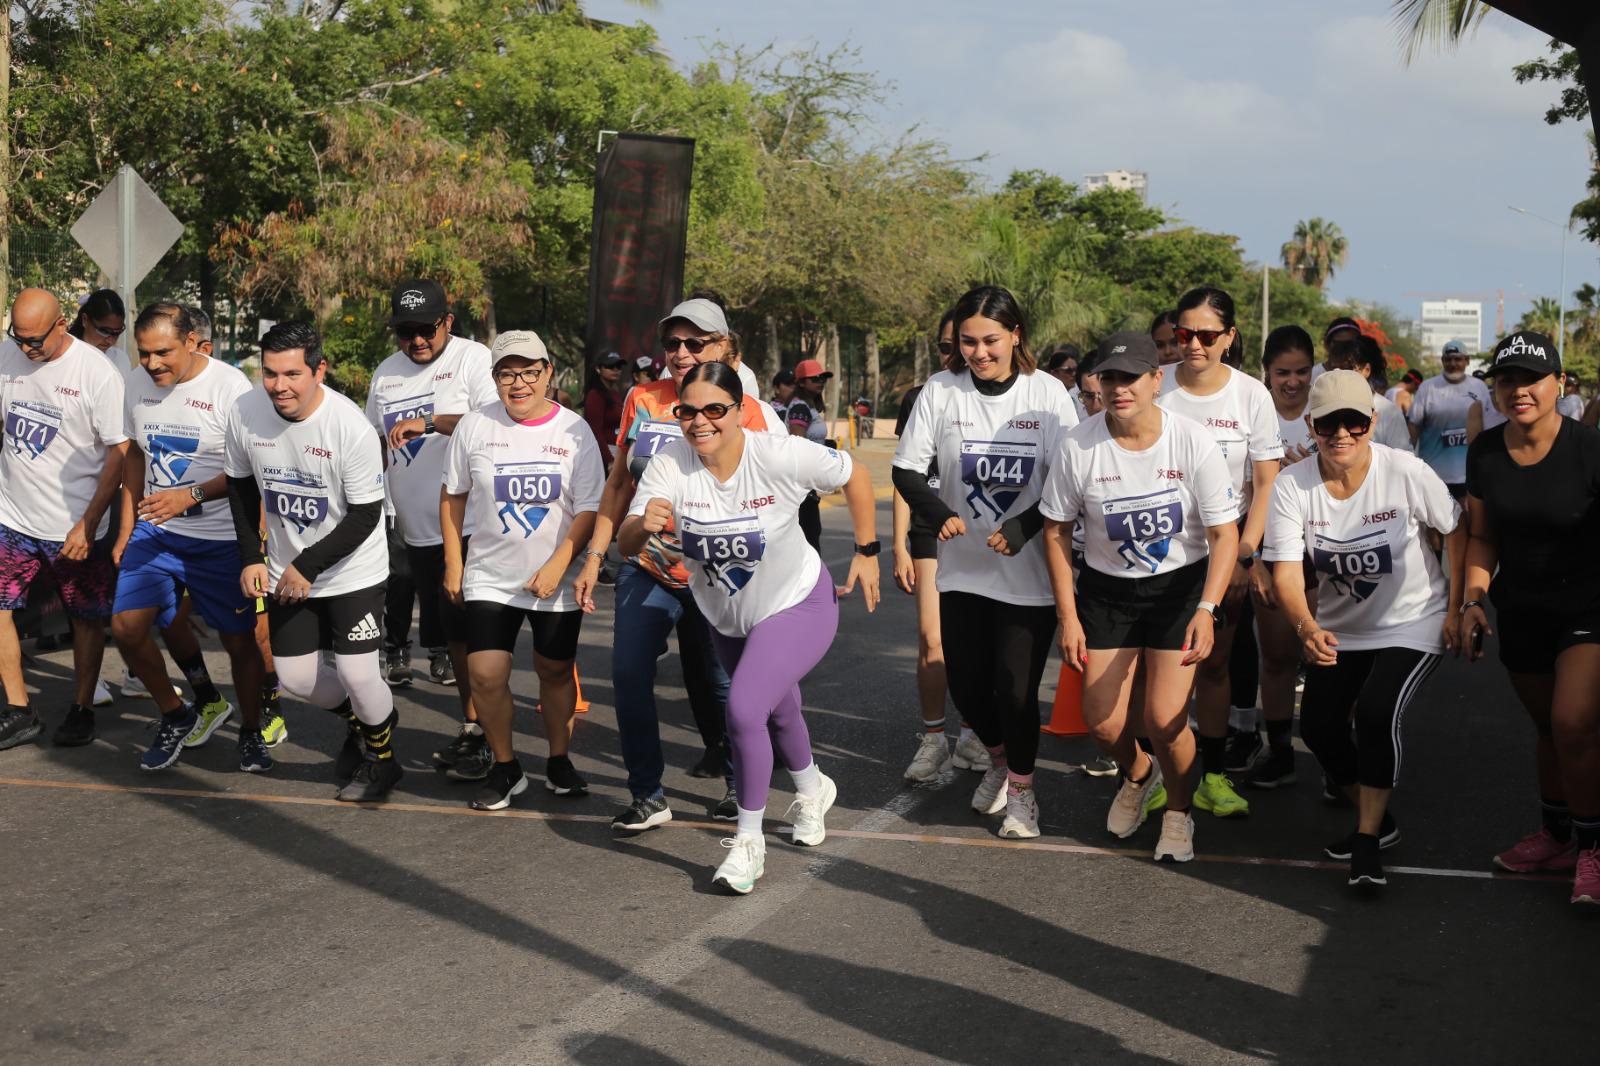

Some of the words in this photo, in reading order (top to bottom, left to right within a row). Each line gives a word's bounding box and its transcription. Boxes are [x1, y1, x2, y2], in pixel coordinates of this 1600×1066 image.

[1511, 335, 1526, 346] LA
[1495, 344, 1547, 365] ADICTIVA
[435, 372, 453, 381] ISDE
[60, 387, 81, 398] ISDE
[191, 399, 214, 412] ISDE
[1015, 420, 1040, 430] ISDE
[1215, 419, 1240, 430] ISDE
[15, 417, 48, 446] 071
[312, 447, 333, 460] ISDE
[549, 445, 570, 458] ISDE
[263, 467, 282, 475] XXIX
[976, 456, 1024, 484] 044
[508, 476, 552, 501] 050
[277, 494, 319, 520] 046
[684, 501, 711, 509] SINALOA
[749, 495, 776, 509] ISDE
[1122, 507, 1174, 538] 135
[1371, 509, 1397, 524] ISDE
[697, 535, 749, 560] 136
[1329, 550, 1380, 575] 109
[347, 628, 381, 641] adidas
